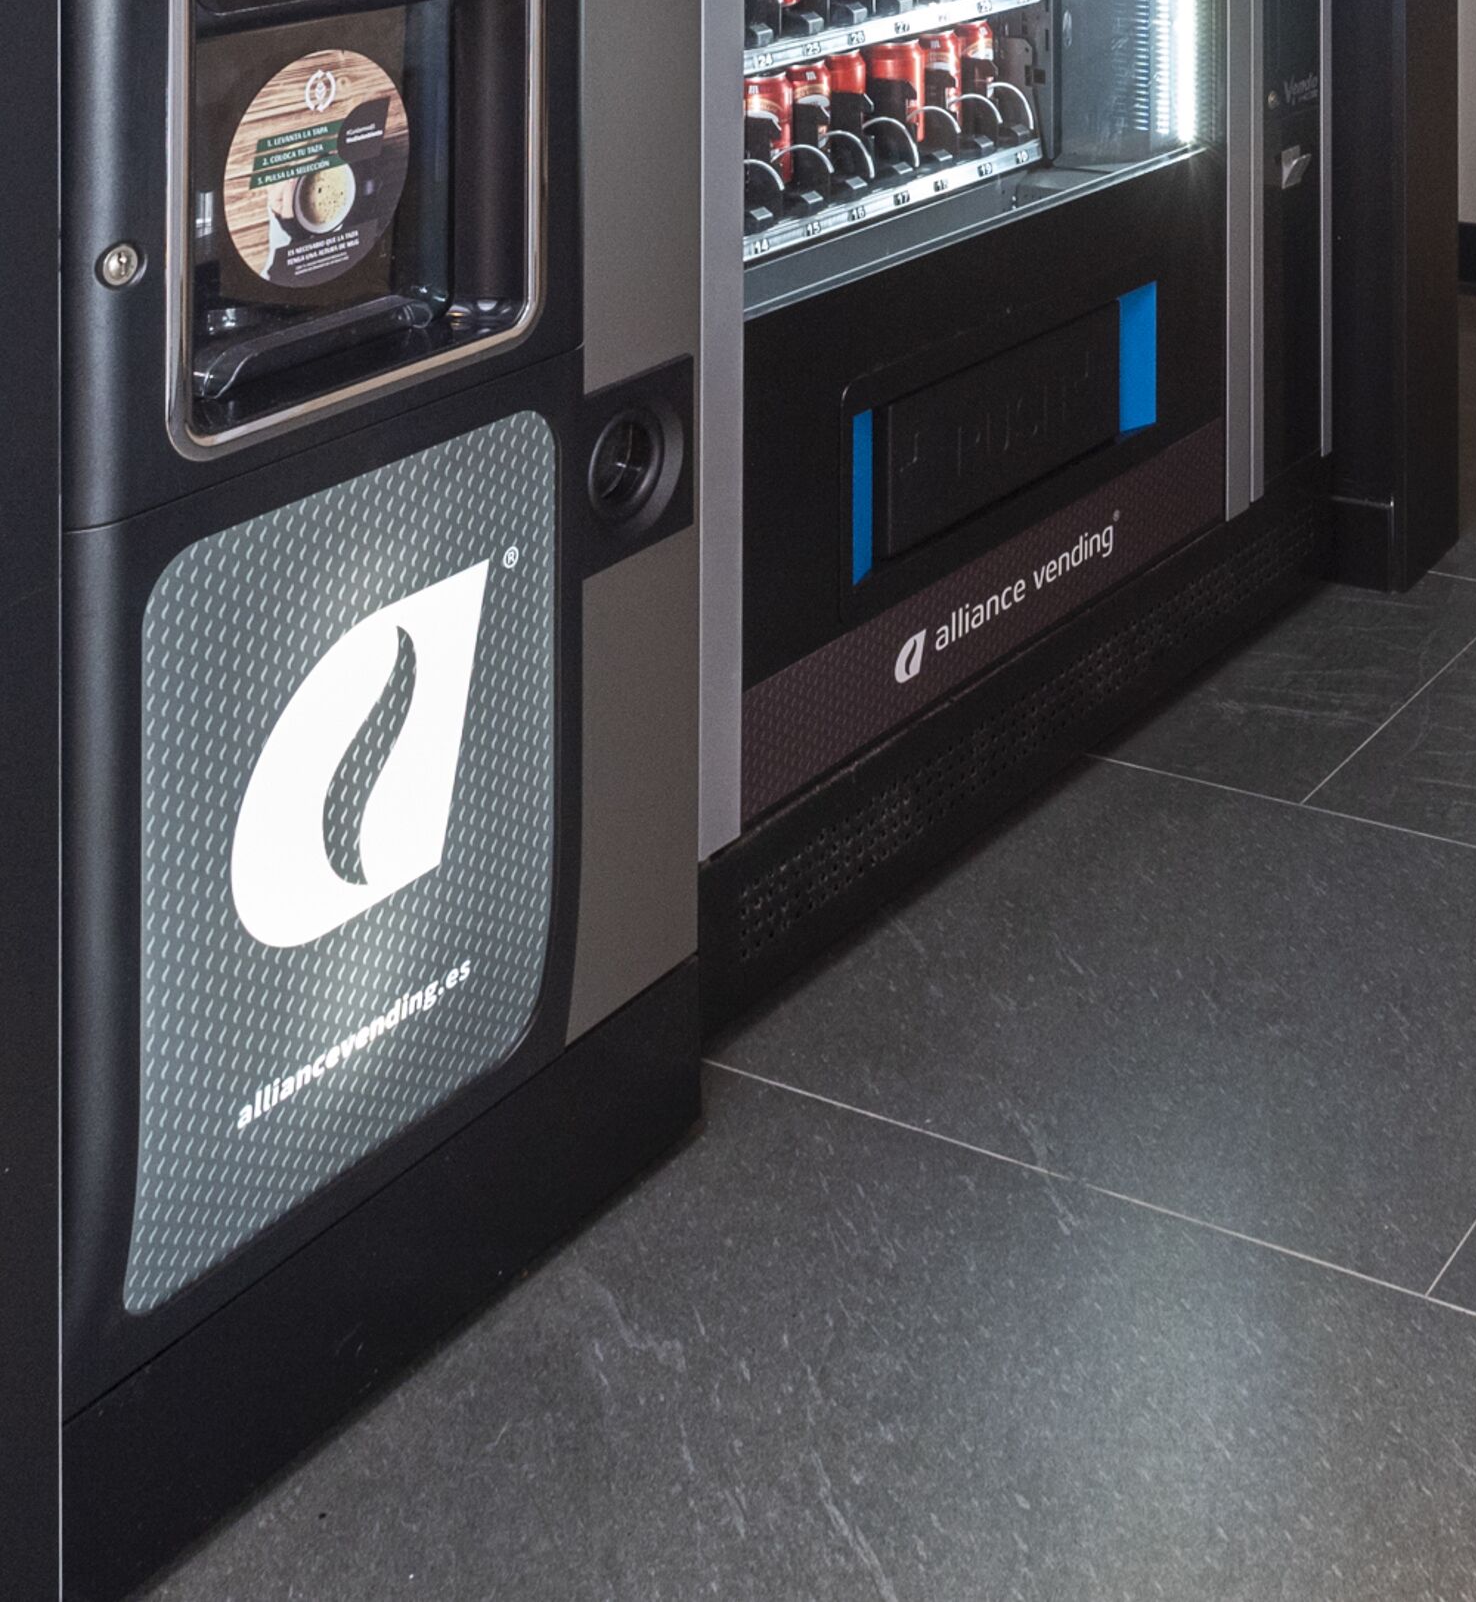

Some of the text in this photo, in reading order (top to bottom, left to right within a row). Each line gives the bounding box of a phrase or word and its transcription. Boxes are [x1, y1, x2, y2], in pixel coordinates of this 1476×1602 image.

[274, 133, 302, 146] LEVANTA
[303, 130, 311, 139] LA
[313, 125, 328, 136] TAPA
[265, 171, 285, 183] PULSA
[286, 169, 295, 178] LA
[296, 159, 330, 175] SELECCIÓN
[270, 150, 296, 164] COLOCA
[297, 147, 305, 156] TU
[307, 143, 323, 154] TAZA
[755, 239, 770, 253] 14
[807, 222, 821, 236] 15
[852, 207, 865, 220] 16
[935, 525, 1114, 651] alliance vending
[236, 958, 472, 1130] alliancevending.es
